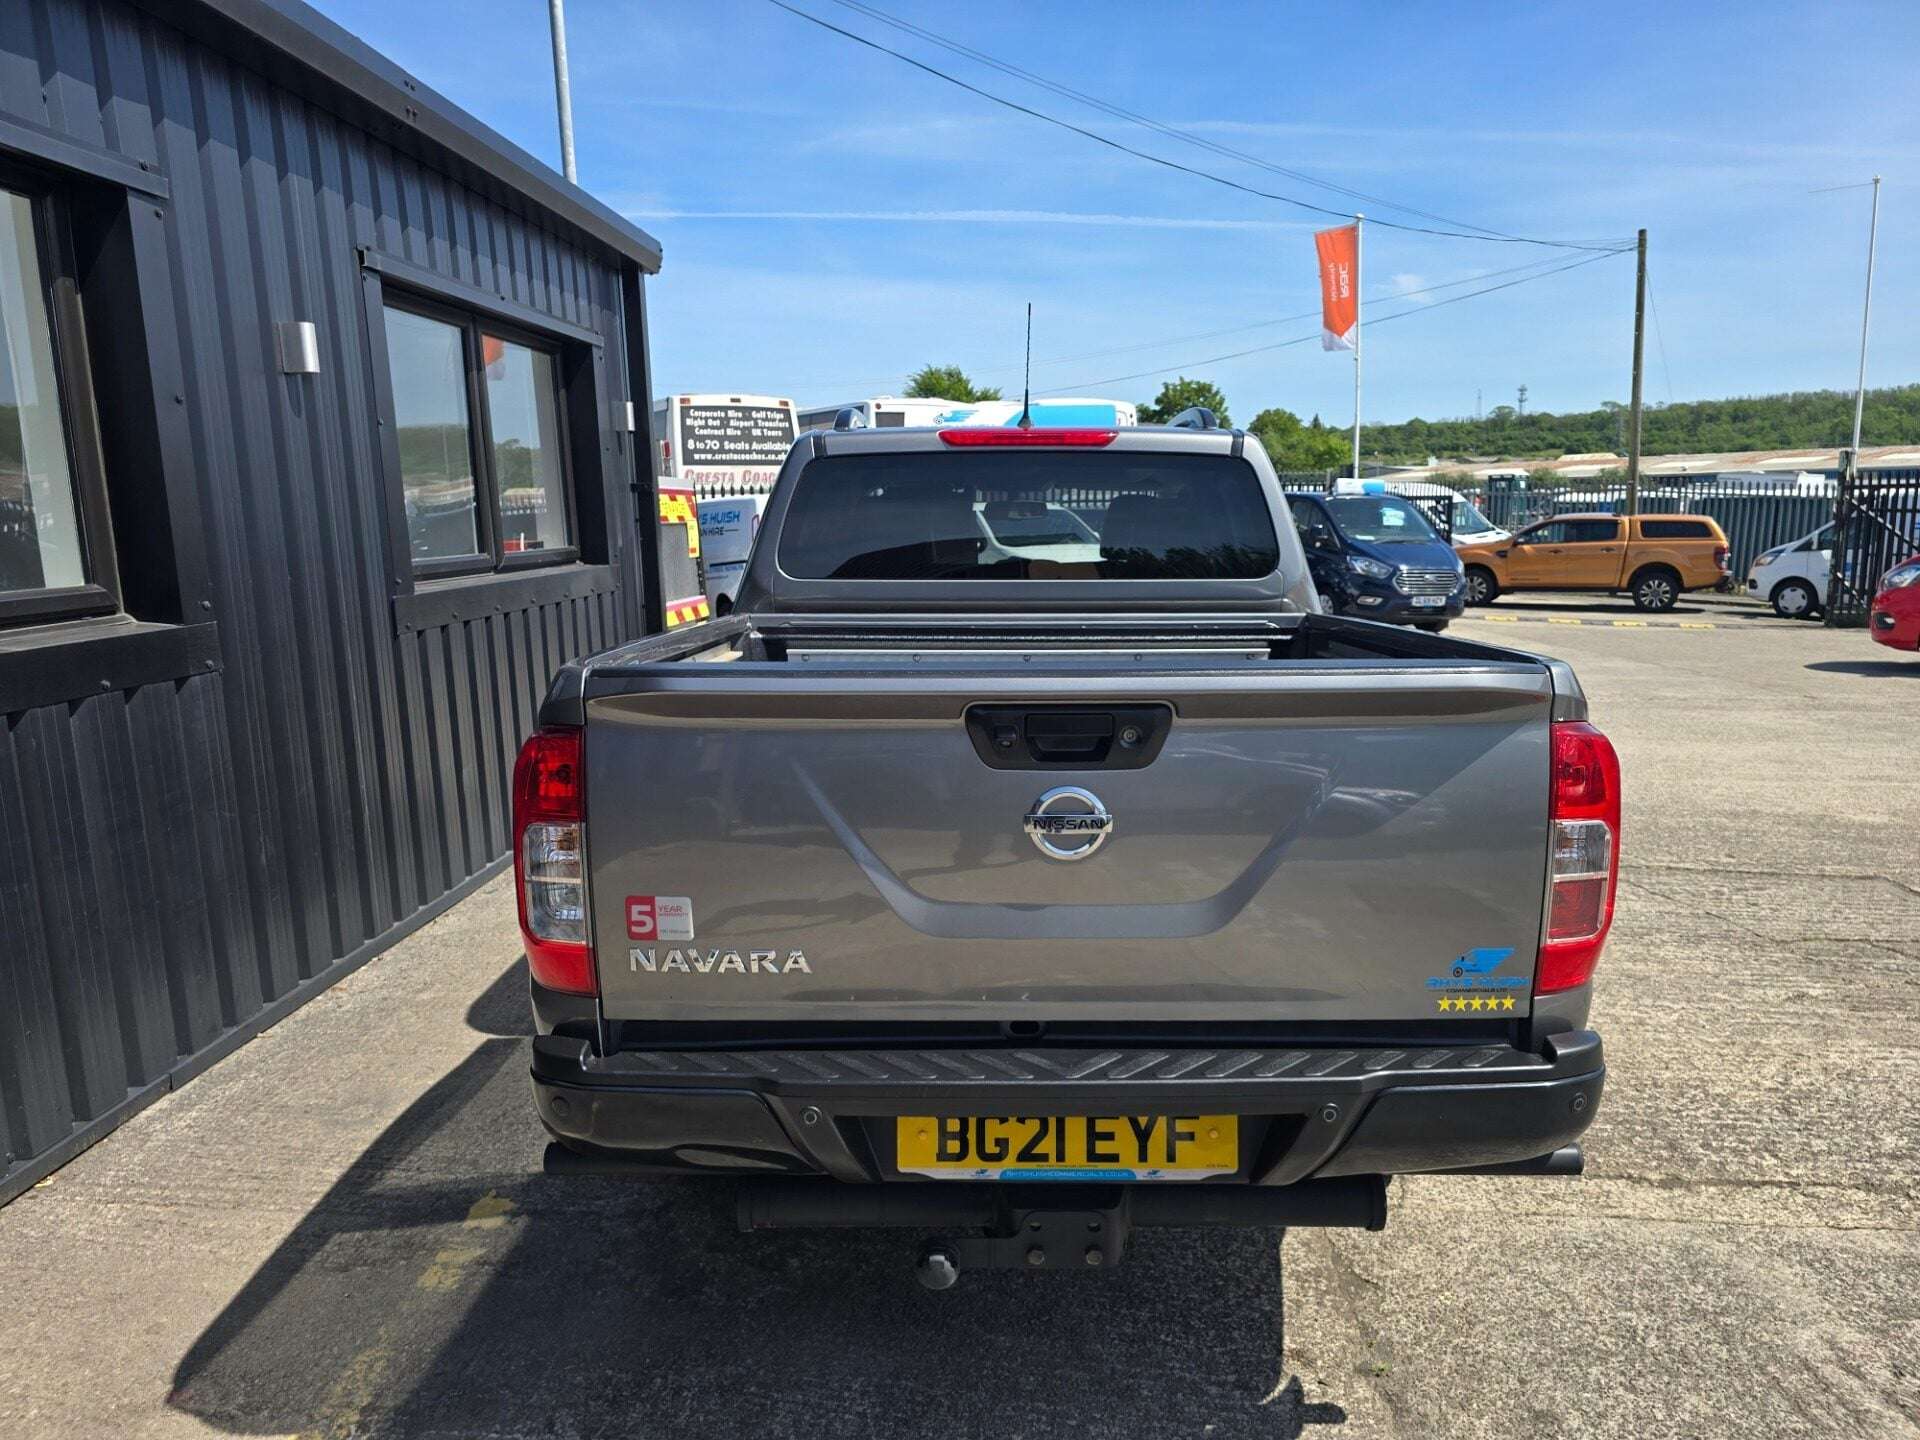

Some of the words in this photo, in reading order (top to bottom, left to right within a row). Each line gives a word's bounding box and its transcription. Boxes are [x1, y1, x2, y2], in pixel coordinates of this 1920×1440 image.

[690, 409, 726, 419] Corporate
[727, 410, 743, 418] Hire
[751, 410, 766, 419] Golf
[767, 411, 784, 420] Trips
[686, 418, 706, 427] Night
[708, 418, 720, 427] Out
[730, 419, 754, 428] Airport
[757, 420, 789, 428] Transfers
[695, 427, 725, 436] Contract
[726, 428, 741, 436] Hire
[751, 428, 762, 437] UK
[763, 428, 783, 437] Tours
[688, 439, 695, 450] 8
[696, 441, 705, 449] to
[705, 440, 720, 450] 70
[724, 440, 750, 450] Seats
[751, 441, 792, 451] Available
[685, 468, 735, 485] CRESTA
[741, 470, 776, 485] COAC
[1033, 818, 1104, 831] NISSAN
[631, 904, 655, 934] 5
[658, 904, 683, 913] YEAR
[629, 947, 813, 974] NAVARA
[936, 1115, 1066, 1163] BG21
[1086, 1115, 1199, 1163] EYF
